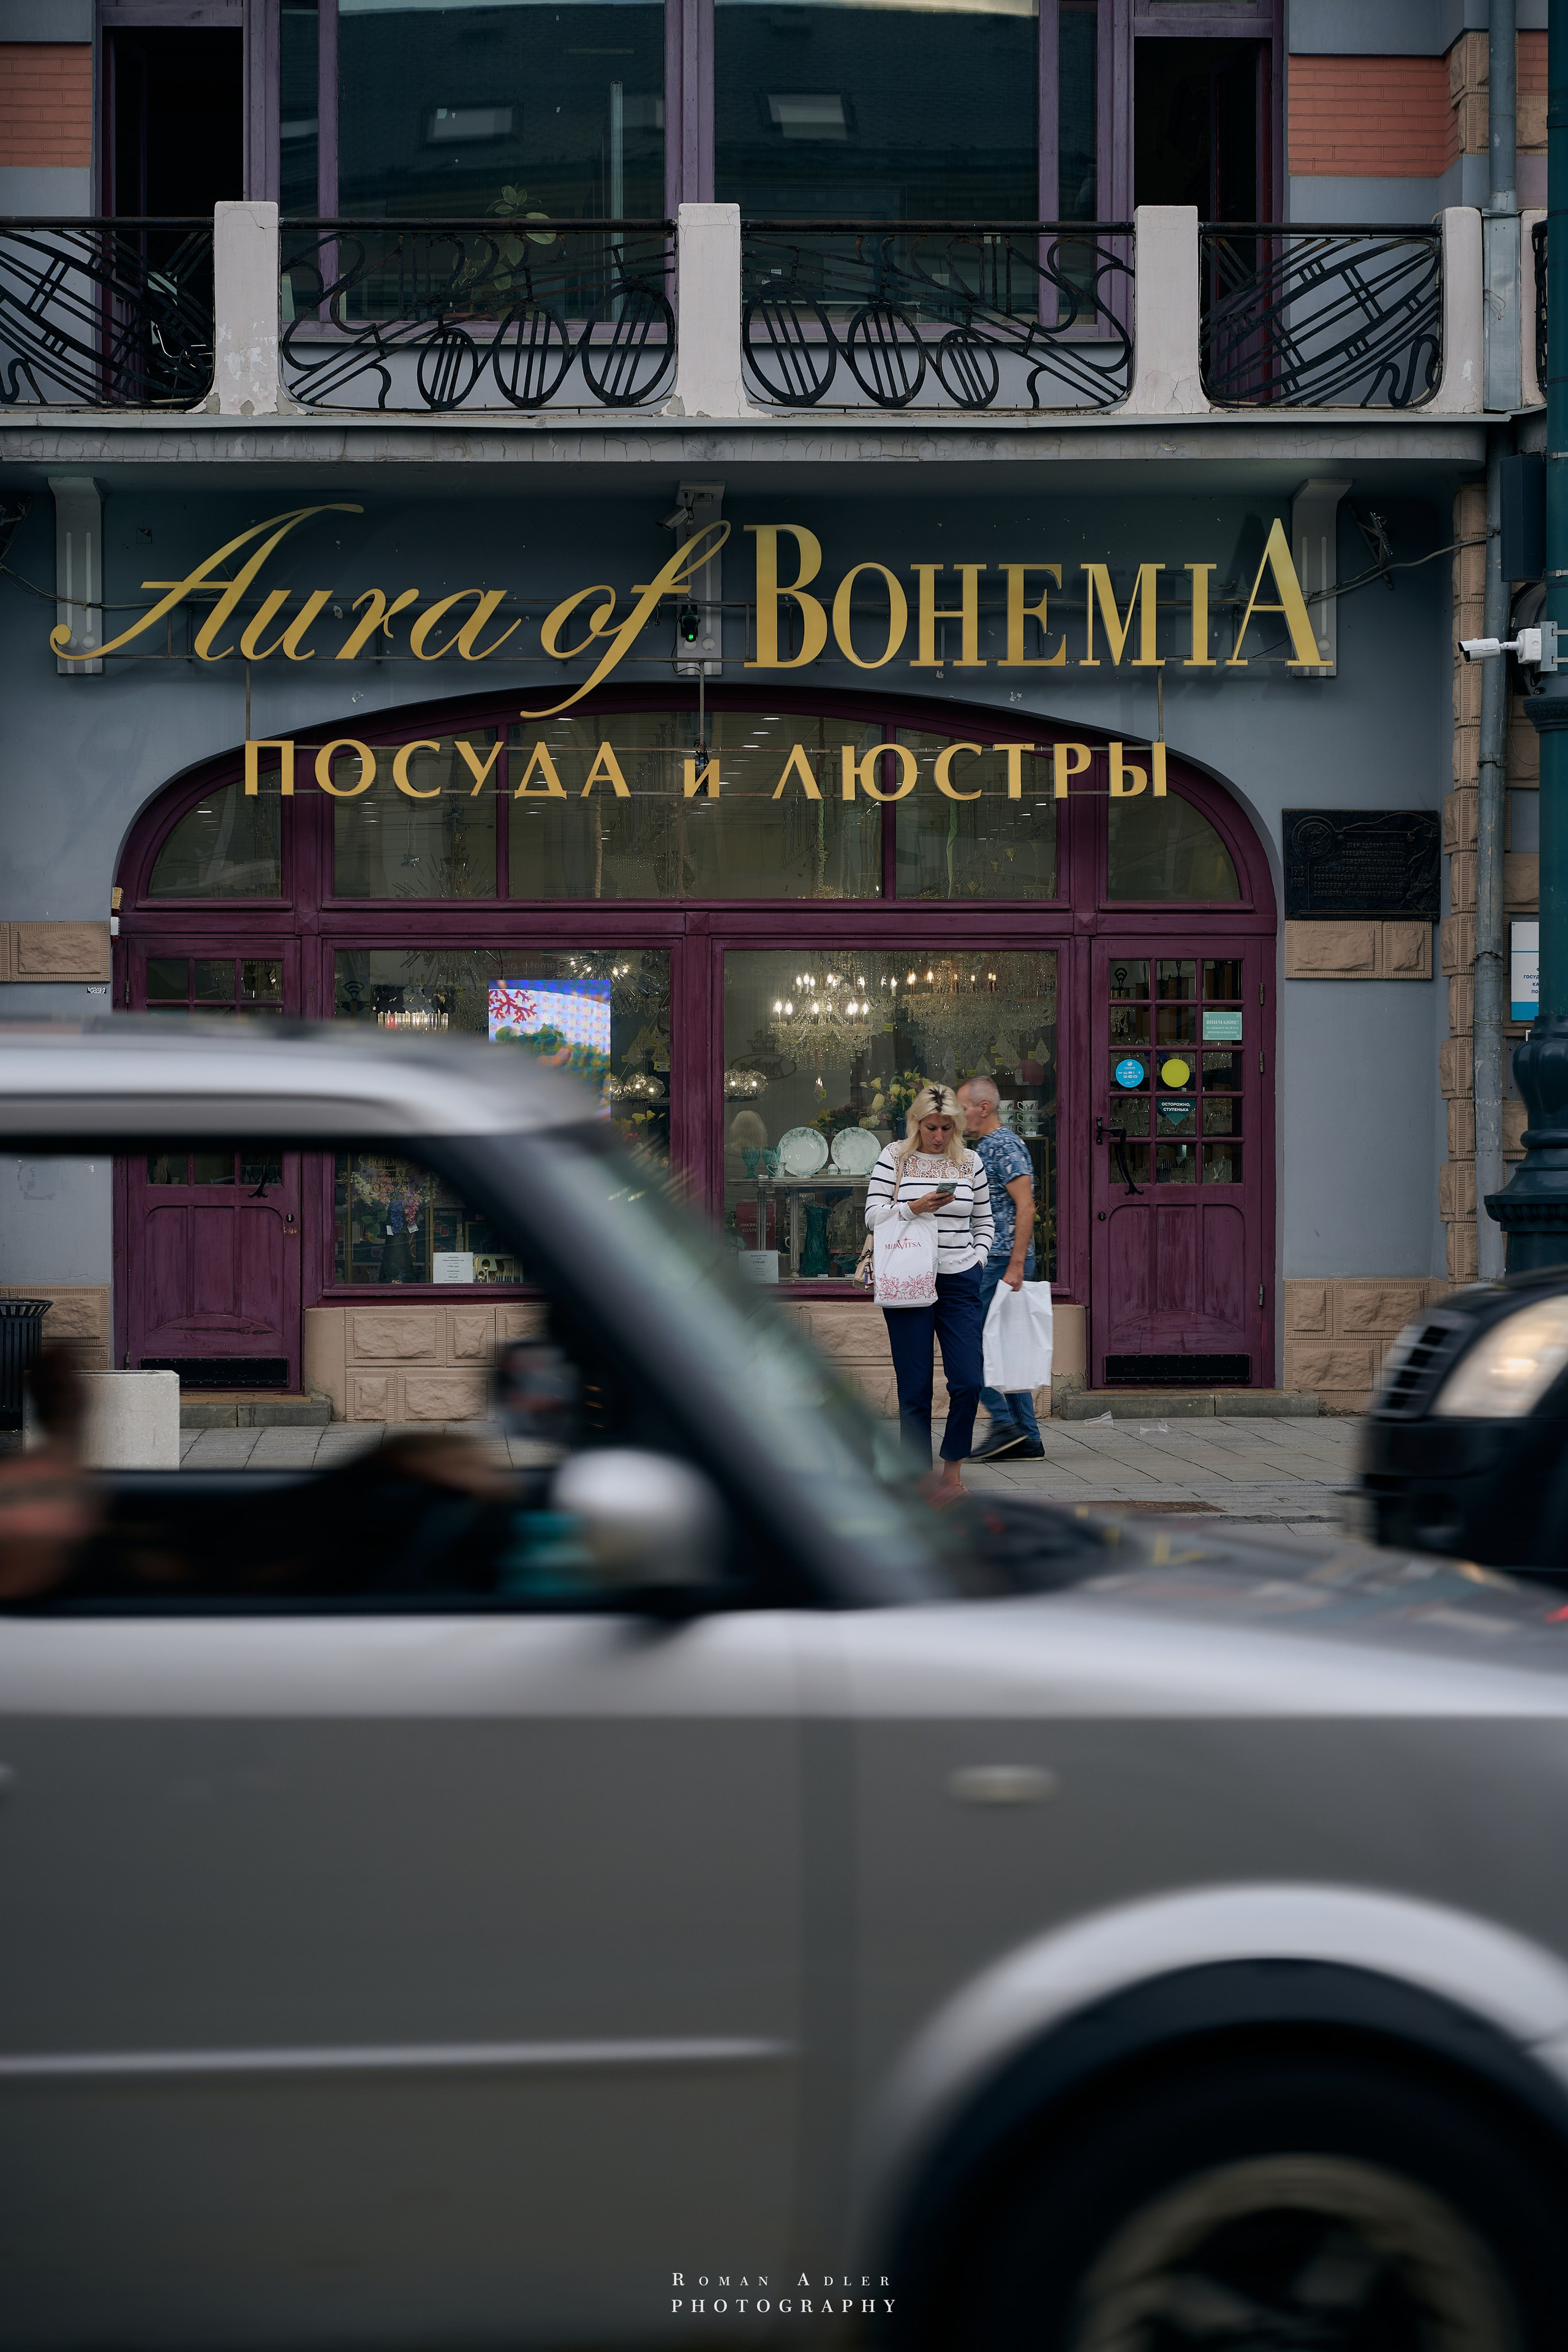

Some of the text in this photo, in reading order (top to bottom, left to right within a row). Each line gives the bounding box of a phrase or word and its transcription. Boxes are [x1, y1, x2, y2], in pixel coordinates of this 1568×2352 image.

[50, 503, 1333, 718] Aura of BOHEMIA
[245, 739, 631, 799] ПОСУДА
[772, 741, 1167, 801] ЛЮСТРЫ
